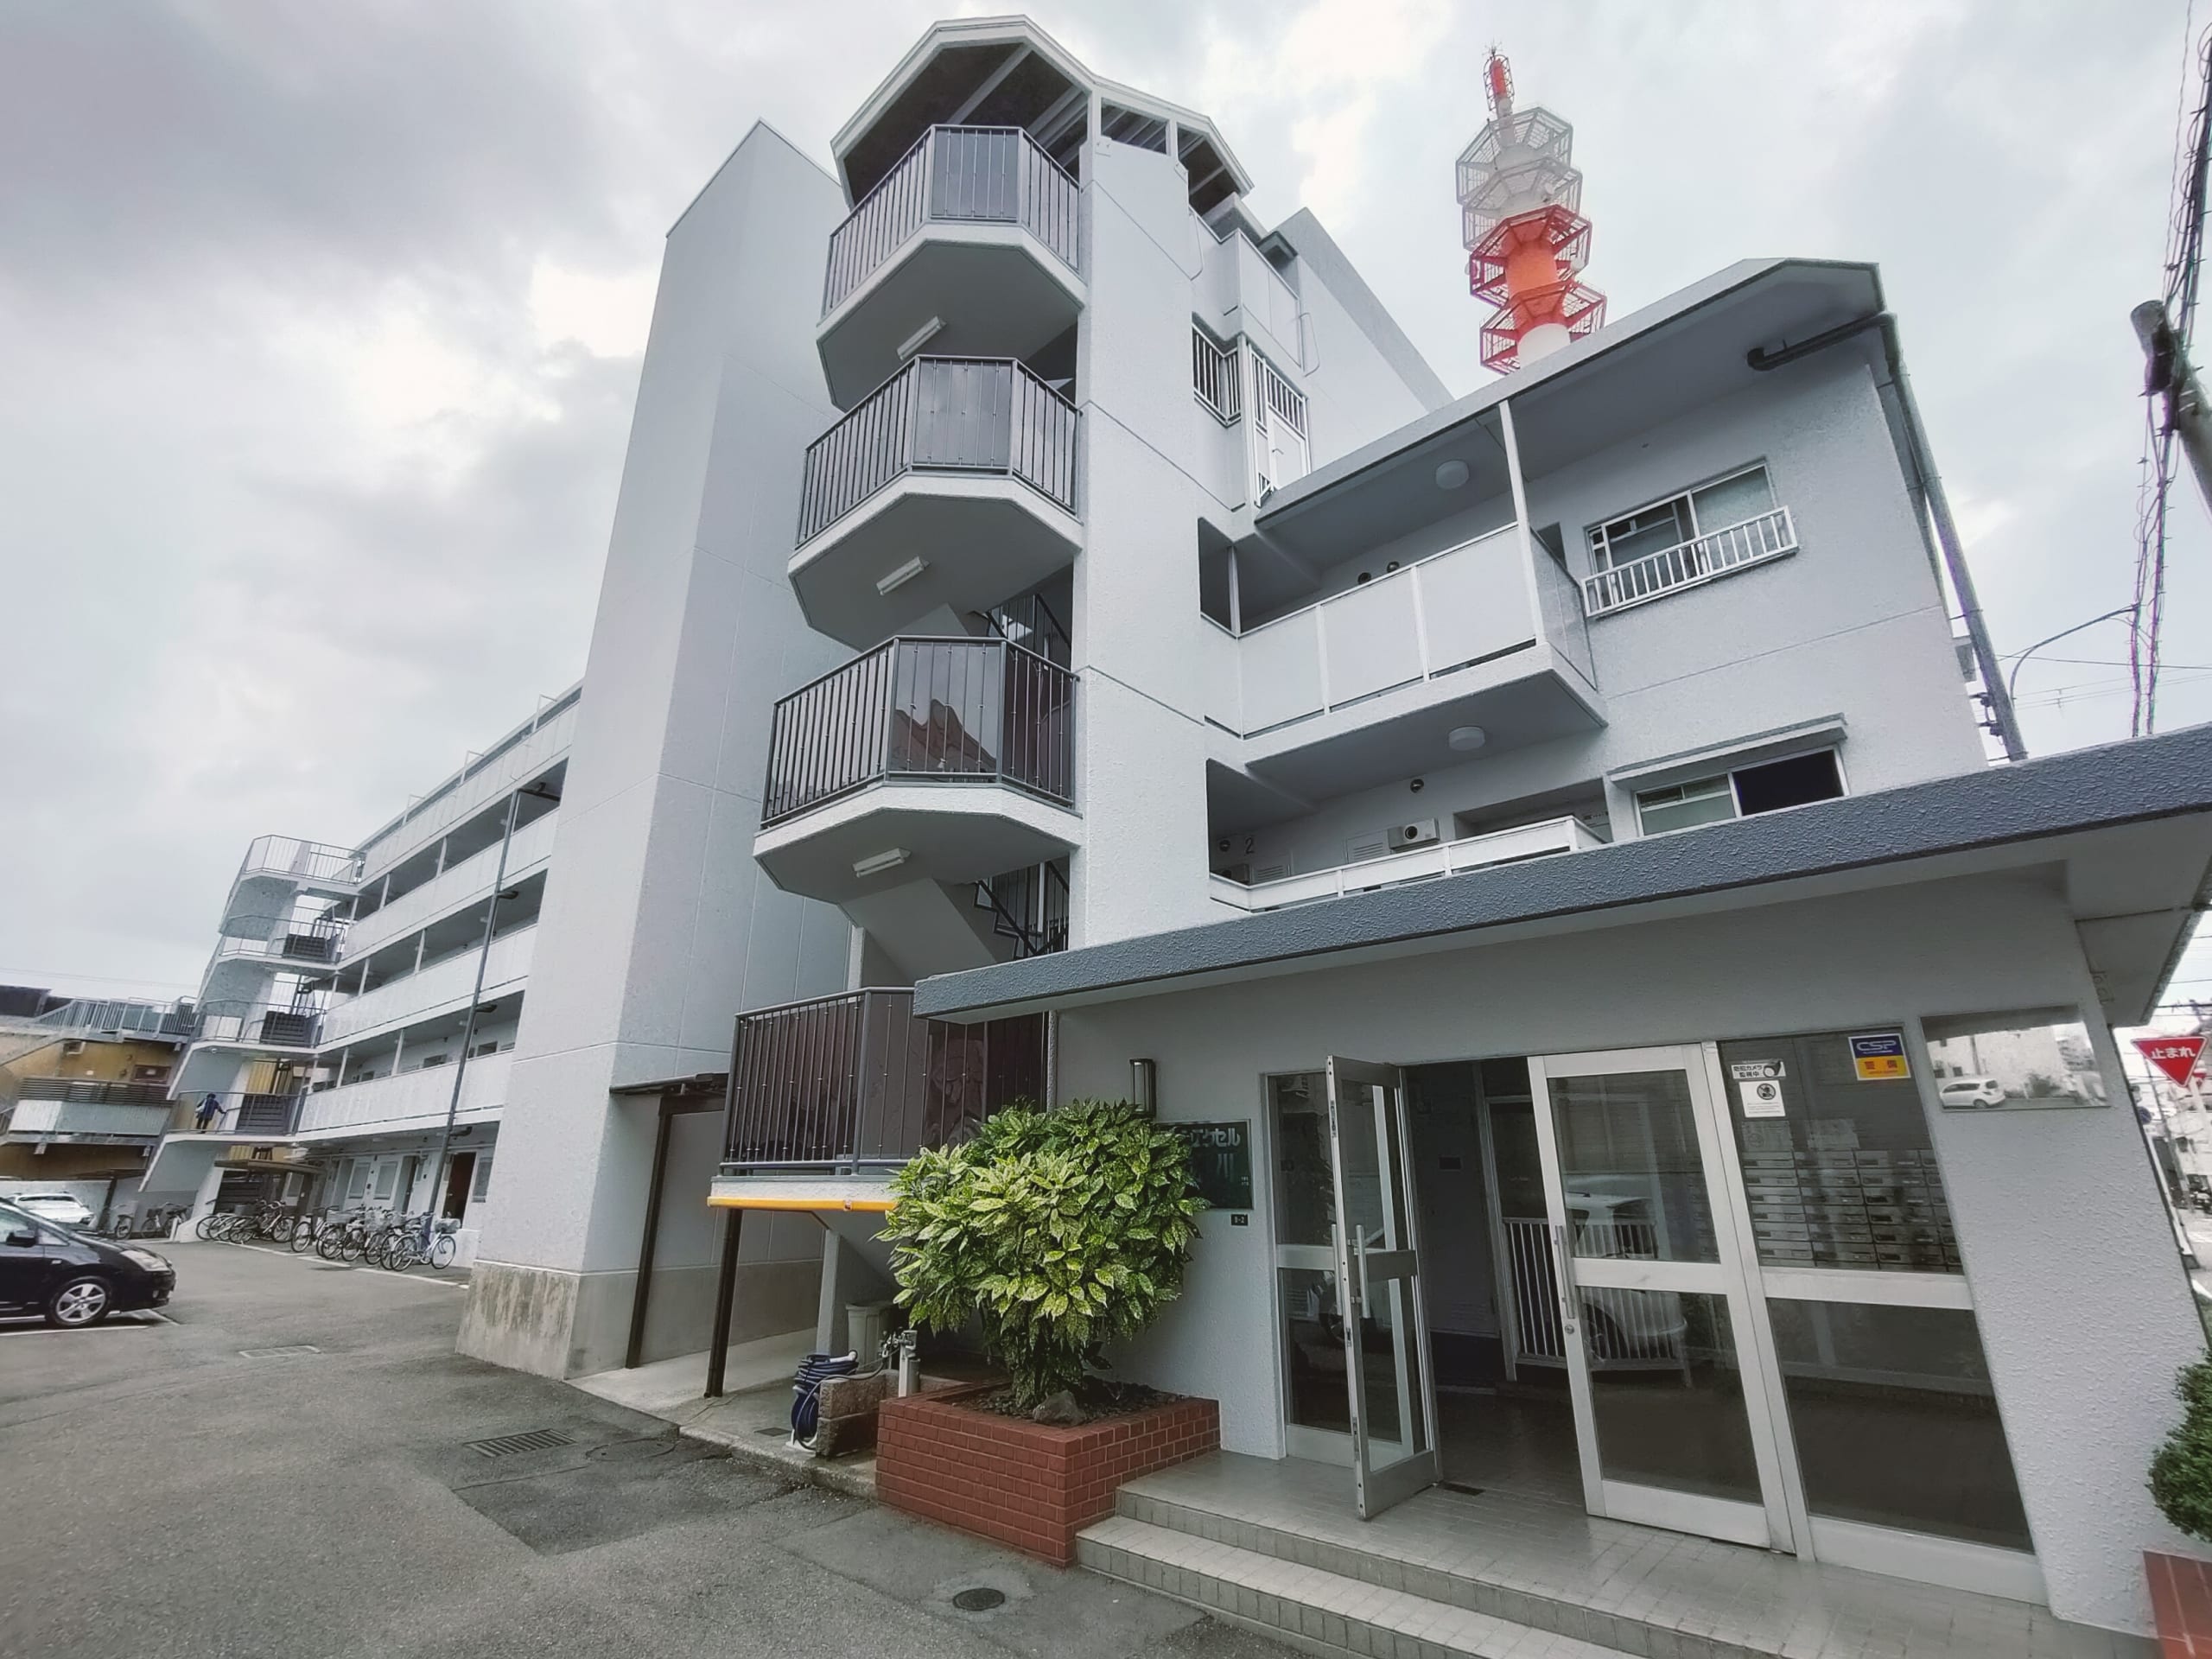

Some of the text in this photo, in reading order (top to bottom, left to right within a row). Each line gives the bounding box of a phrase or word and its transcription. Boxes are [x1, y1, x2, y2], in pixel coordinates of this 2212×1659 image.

[1245, 836, 1254, 855] 2
[1856, 1040, 1897, 1051] CSP
[2151, 1046, 2196, 1059] 止まれ
